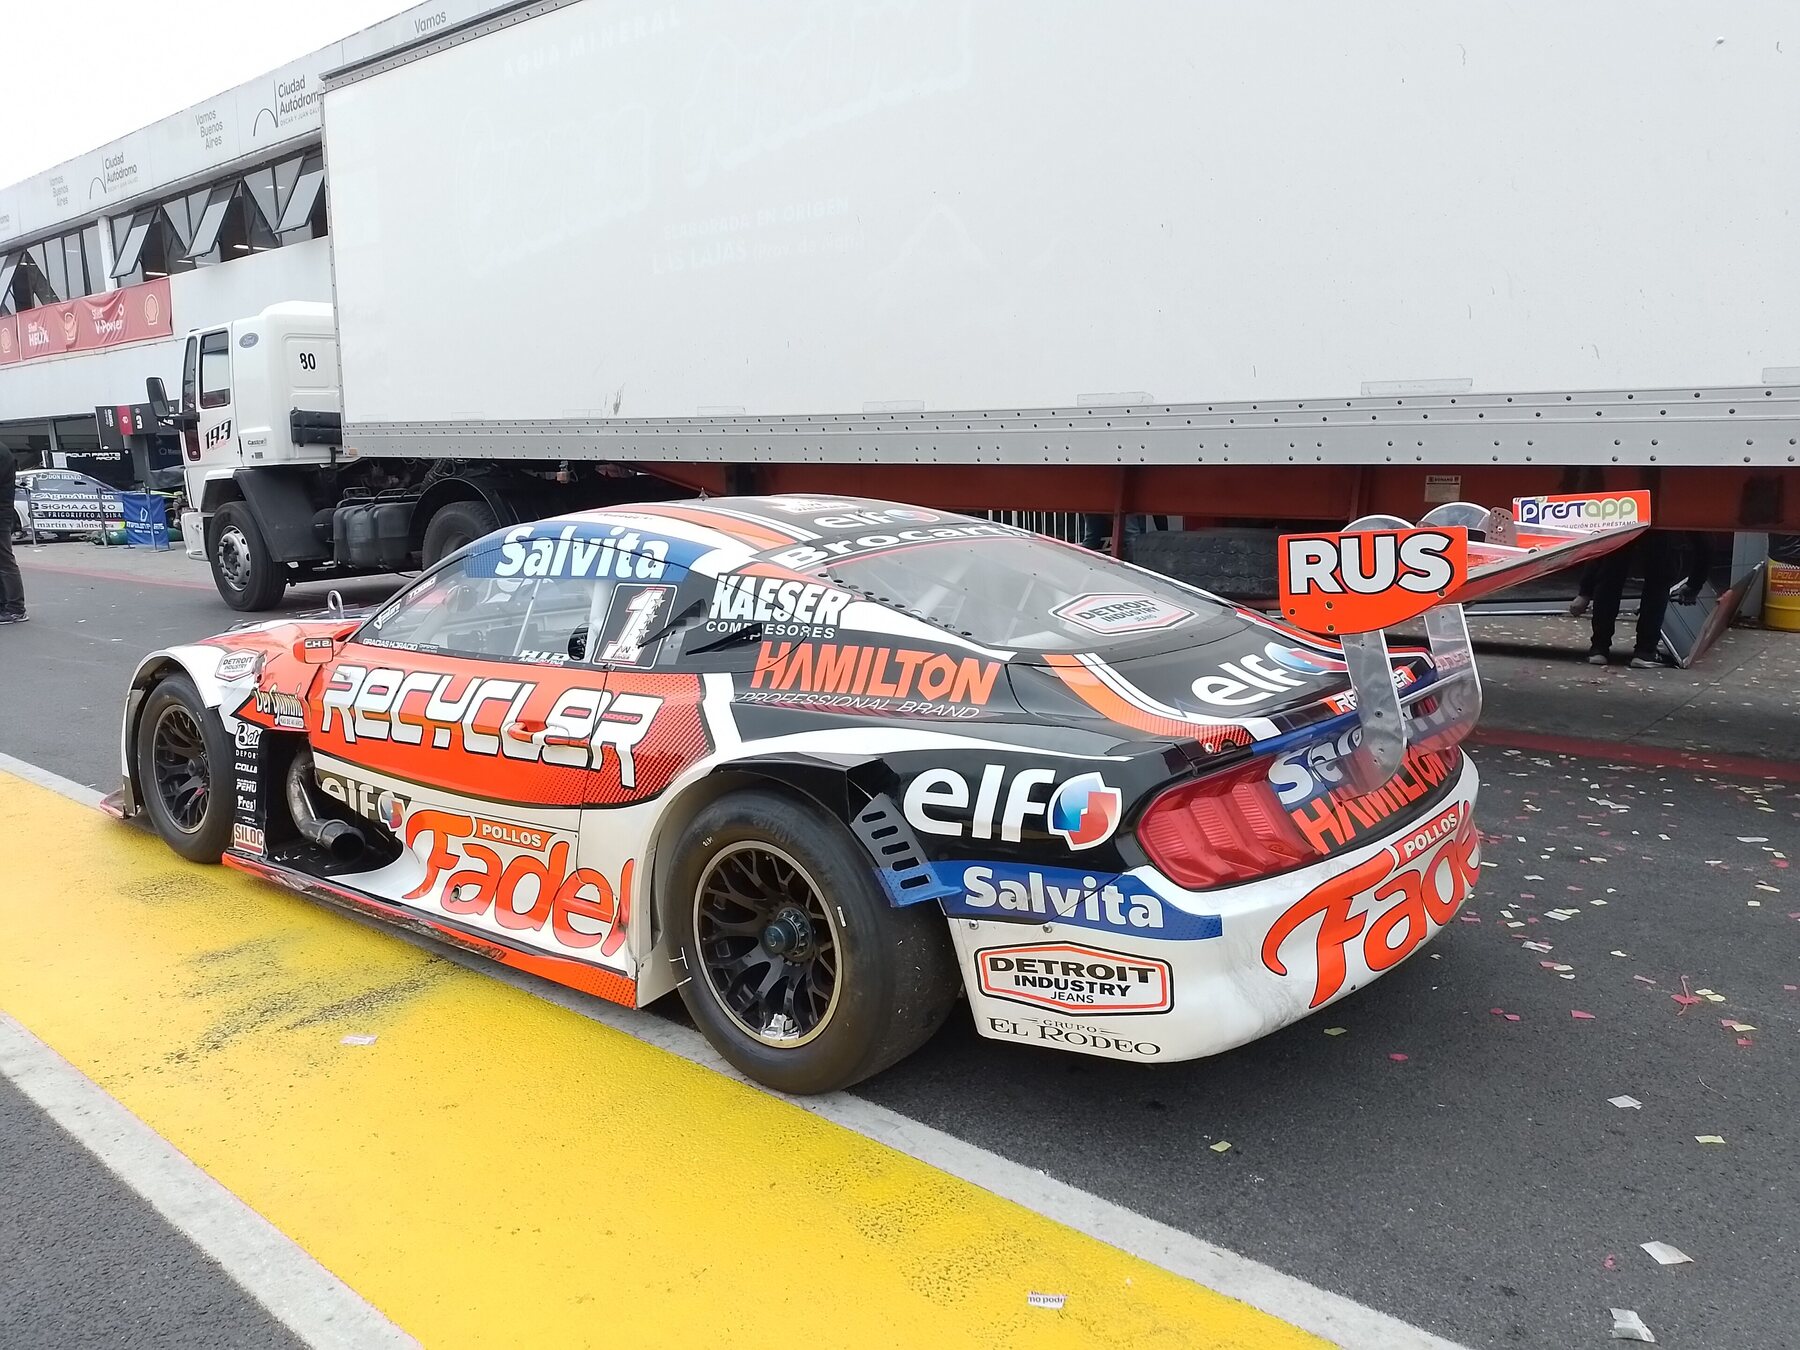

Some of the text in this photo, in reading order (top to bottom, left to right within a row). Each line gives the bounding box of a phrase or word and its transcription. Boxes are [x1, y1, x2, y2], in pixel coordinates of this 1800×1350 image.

[414, 11, 447, 34] Vamos
[278, 74, 306, 98] Ciudad
[279, 91, 320, 116] Autódrom
[195, 110, 217, 126] Vamos
[200, 121, 223, 138] Buenos
[205, 136, 222, 150] Aires
[105, 152, 125, 170] Ciudad
[106, 163, 138, 184] Autódromo
[205, 420, 232, 449] 193
[813, 510, 895, 529] elf
[495, 525, 669, 580] Salvita
[1288, 533, 1453, 595] RUS
[708, 574, 852, 626] KAESER
[1075, 599, 1156, 620] DETROIT
[600, 587, 667, 664] 1
[1101, 606, 1160, 622] INDUSTRY
[706, 620, 835, 639] COMESORES
[223, 656, 254, 665] DETROIT
[750, 641, 1001, 705] HAMILTON
[1191, 653, 1306, 707] elf
[736, 692, 980, 718] PROFESSIONAL BRAND
[235, 749, 259, 759] DEPOR
[321, 777, 376, 819] elf
[903, 764, 1056, 843] elf
[481, 824, 542, 847] POLLOS
[1404, 812, 1457, 859] POLLOS
[403, 808, 635, 957] Fadel
[963, 866, 1164, 928] Salvita
[990, 957, 1155, 984] DETROIT
[1015, 974, 1131, 998] INDUSTRY
[1050, 991, 1095, 1004] JEANS
[987, 1017, 1161, 1056] EL RODEO
[1043, 1018, 1098, 1033] GRUPO
